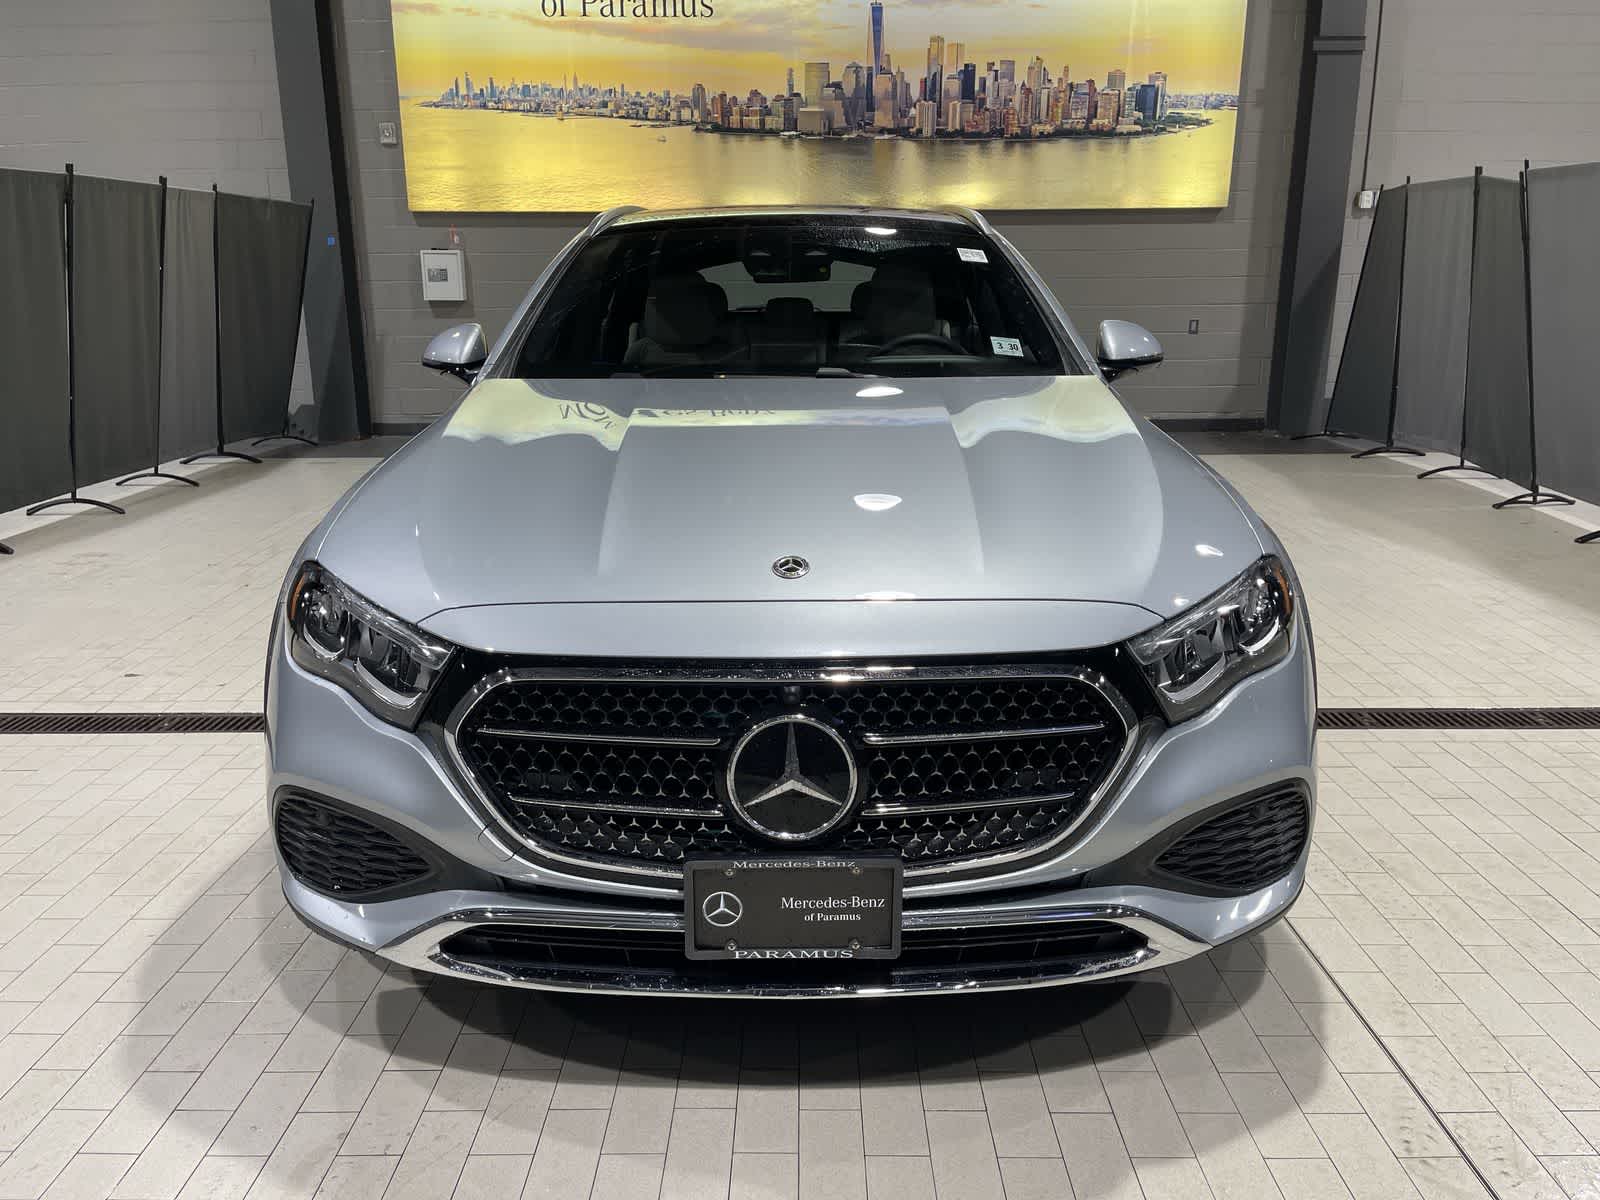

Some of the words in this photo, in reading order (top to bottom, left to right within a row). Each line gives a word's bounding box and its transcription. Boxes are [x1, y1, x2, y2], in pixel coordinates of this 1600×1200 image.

[580, 0, 714, 18] Paramus
[996, 341, 1004, 350] 3
[1007, 342, 1019, 352] 30
[732, 860, 857, 869] Mercedes-Benz
[781, 896, 886, 909] Mercedes-Benz
[804, 912, 815, 921] of
[817, 912, 861, 921] Paramus
[734, 950, 854, 959] PARAMUS
